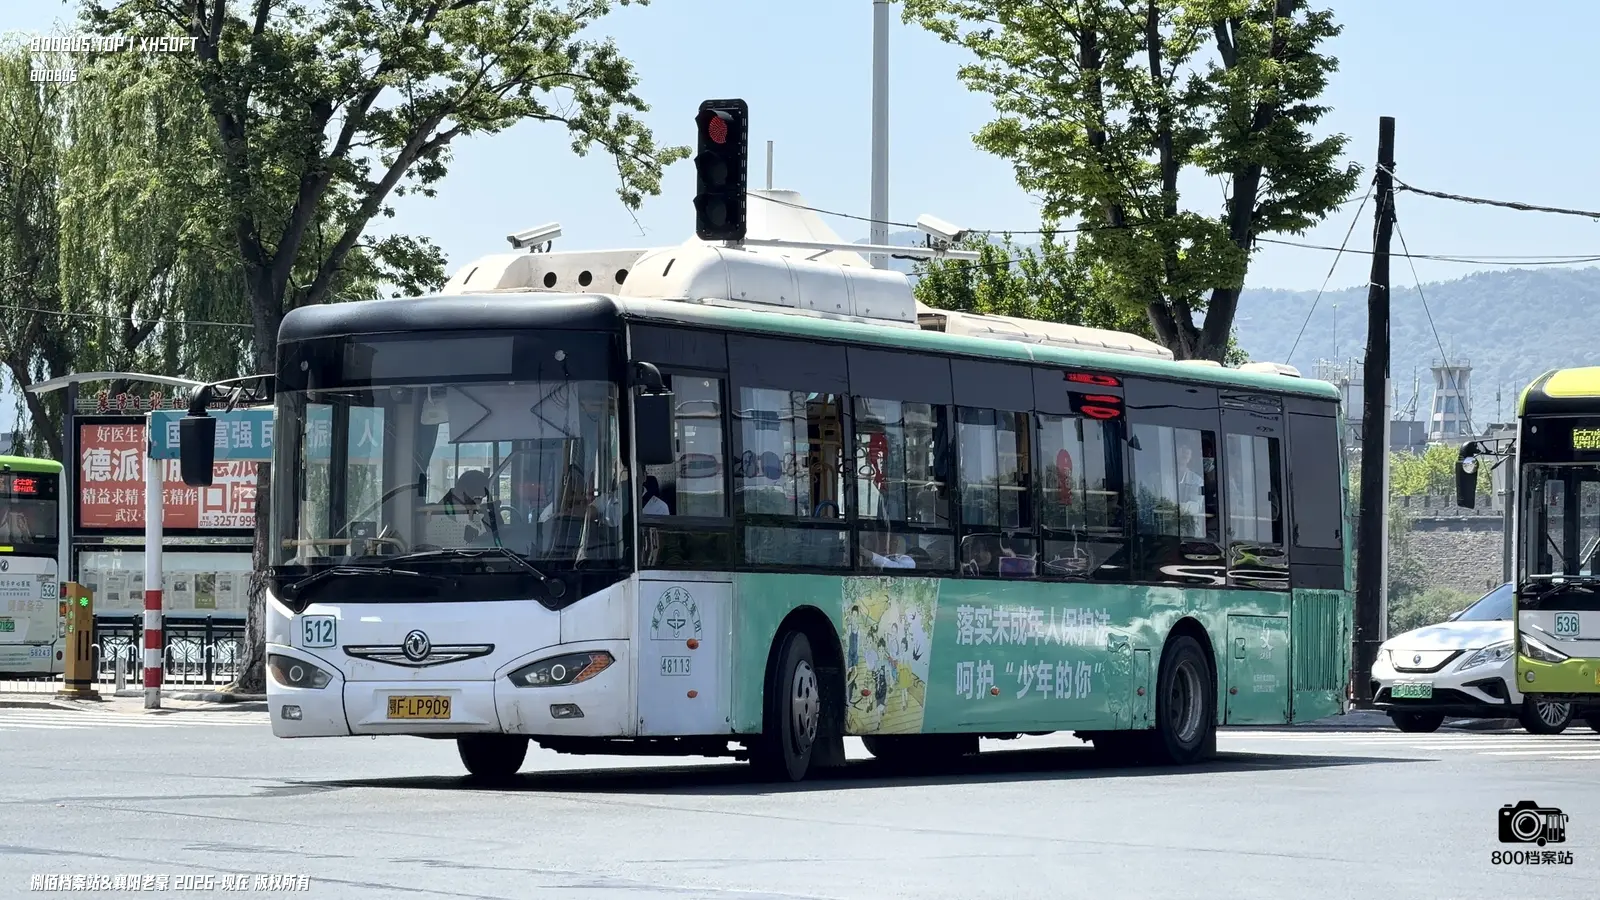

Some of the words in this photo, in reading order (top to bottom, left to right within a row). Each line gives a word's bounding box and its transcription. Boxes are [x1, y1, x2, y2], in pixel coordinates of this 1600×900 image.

[166, 421, 253, 449] 国富强
[82, 447, 182, 482] 德派
[213, 515, 237, 527] 3257
[43, 584, 55, 597] 532
[305, 619, 333, 643] 512
[956, 604, 1111, 646] 落实未成年人保护法
[1557, 616, 1577, 632] 536
[661, 659, 690, 673] 48113
